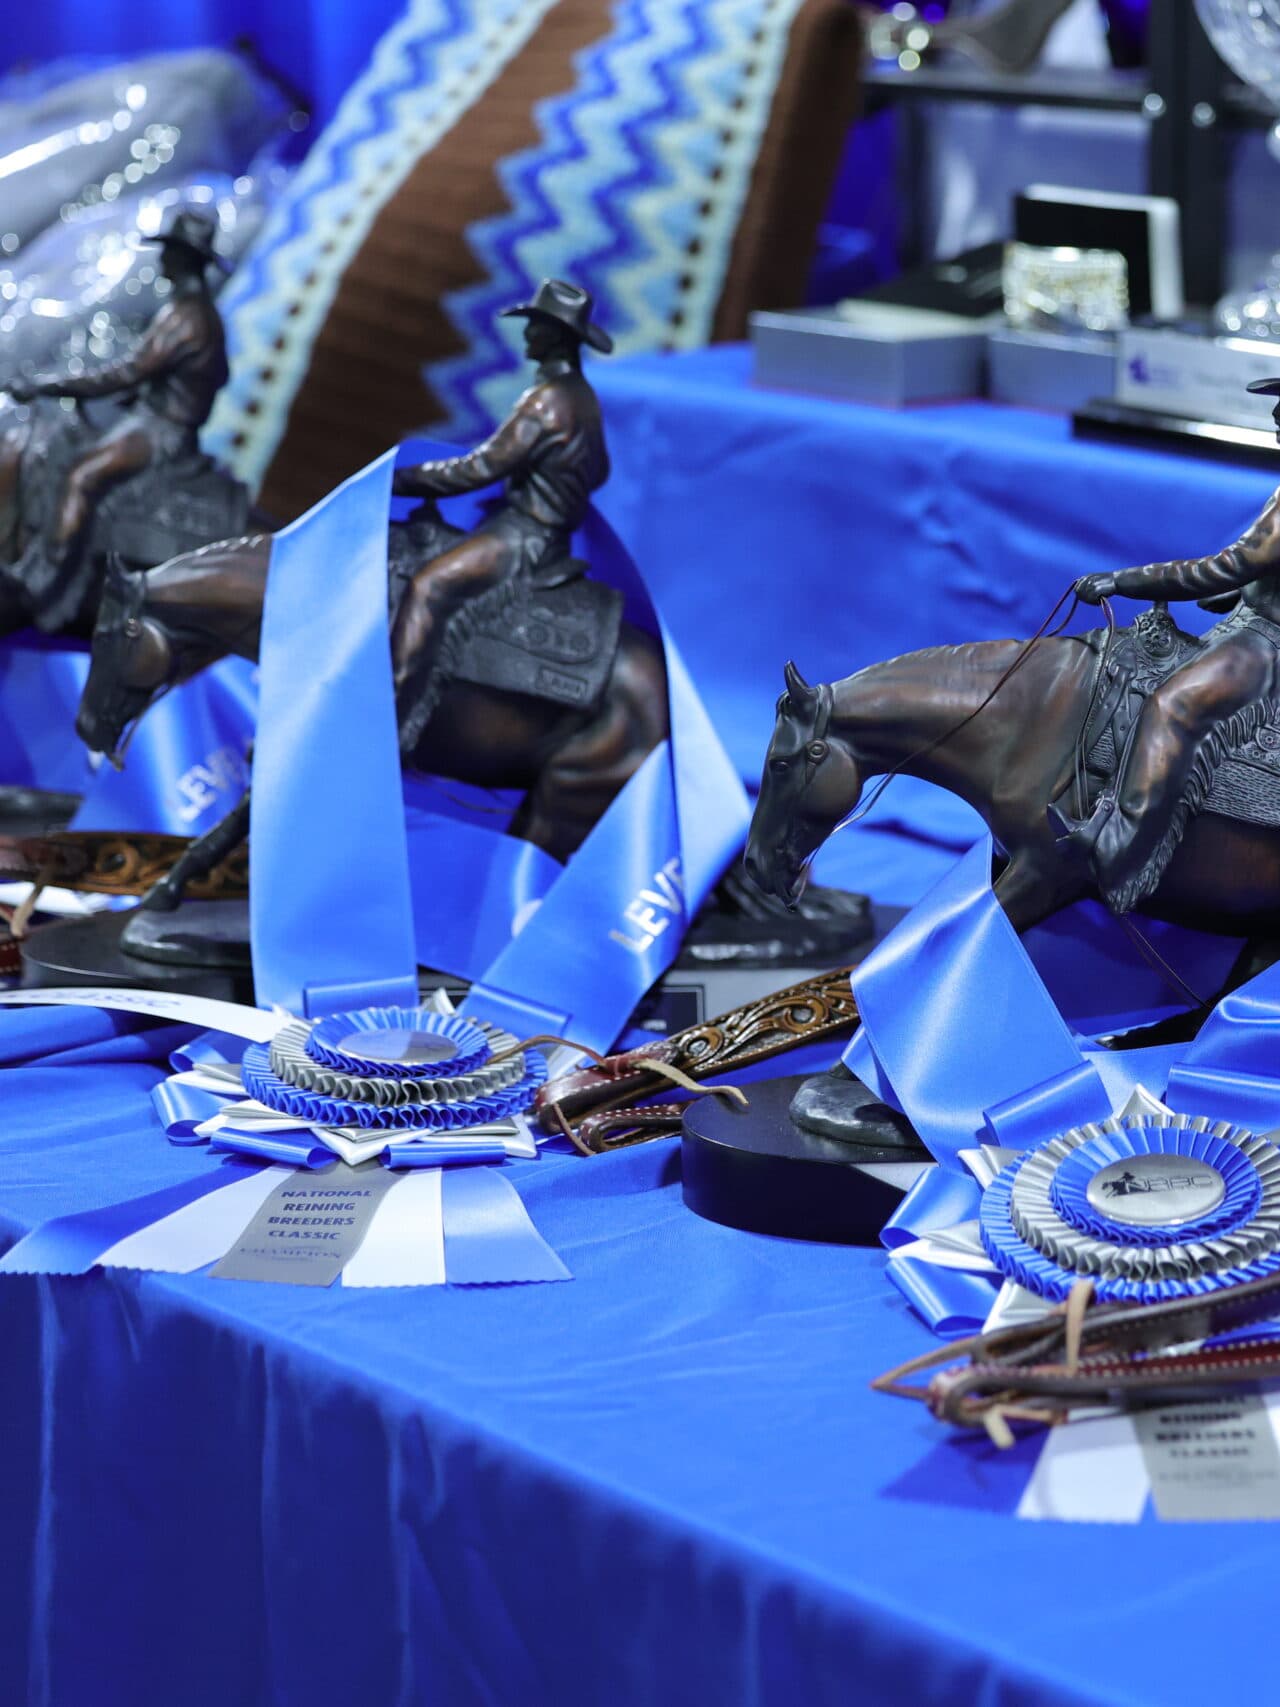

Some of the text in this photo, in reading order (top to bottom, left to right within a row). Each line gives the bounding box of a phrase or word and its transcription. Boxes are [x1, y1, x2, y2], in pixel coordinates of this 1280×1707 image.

[281, 1190, 373, 1198] NATIONAL
[283, 1202, 356, 1212] REINING
[268, 1216, 356, 1226] BREEDERS
[268, 1230, 341, 1240] CLASSIC
